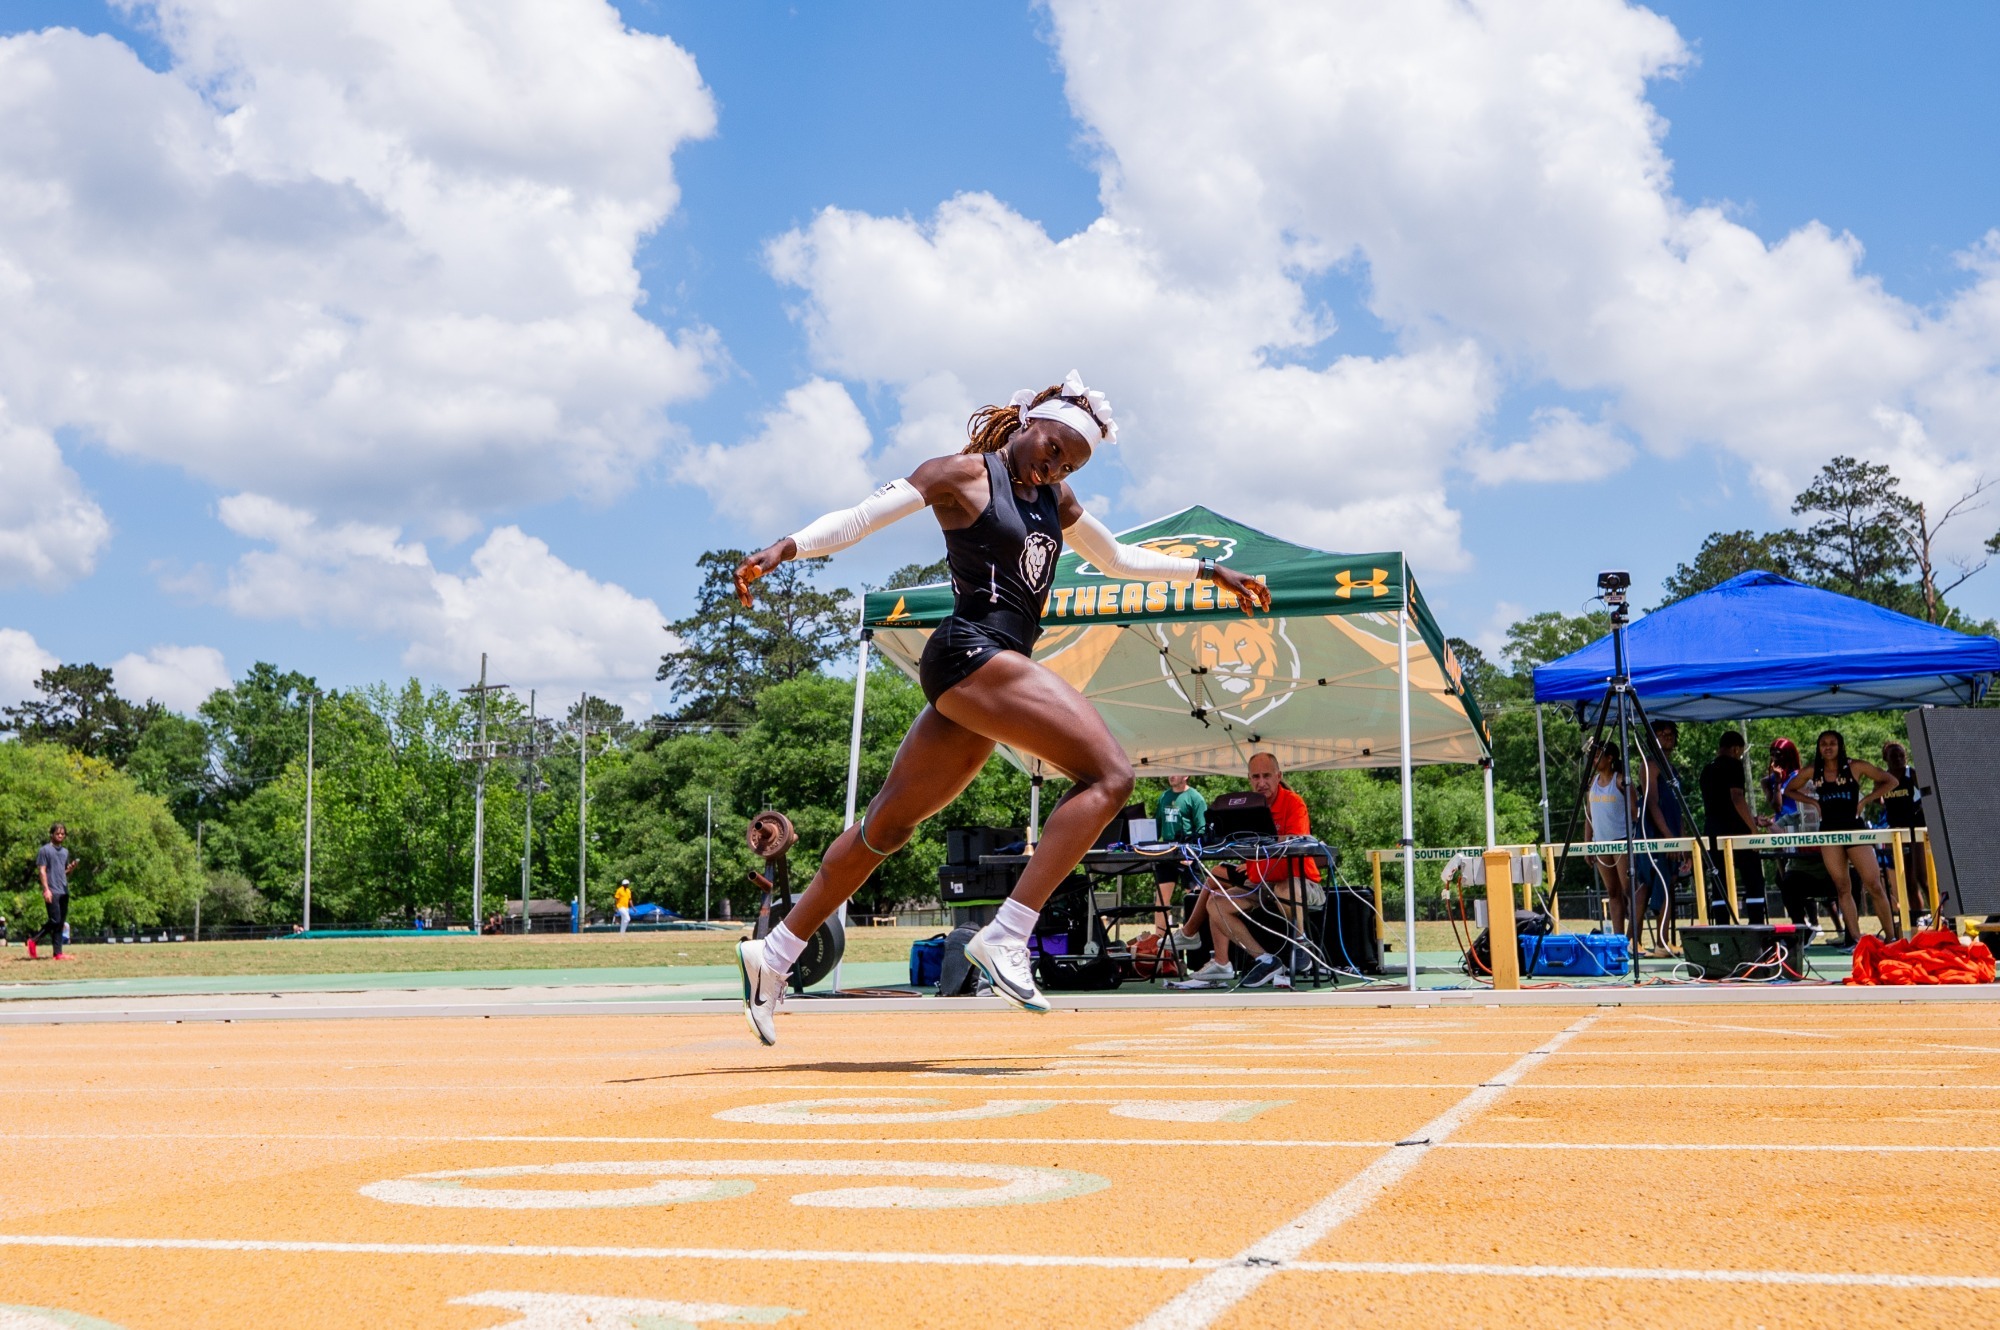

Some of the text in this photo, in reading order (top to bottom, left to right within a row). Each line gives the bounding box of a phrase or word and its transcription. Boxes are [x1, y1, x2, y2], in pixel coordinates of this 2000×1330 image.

[1041, 574, 1267, 618] THEASTER
[1771, 833, 1852, 846] SOUTHEASTERN
[1587, 841, 1658, 854] SOUTHEATERN
[801, 966, 812, 977] 45
[358, 1159, 1111, 1210] 6
